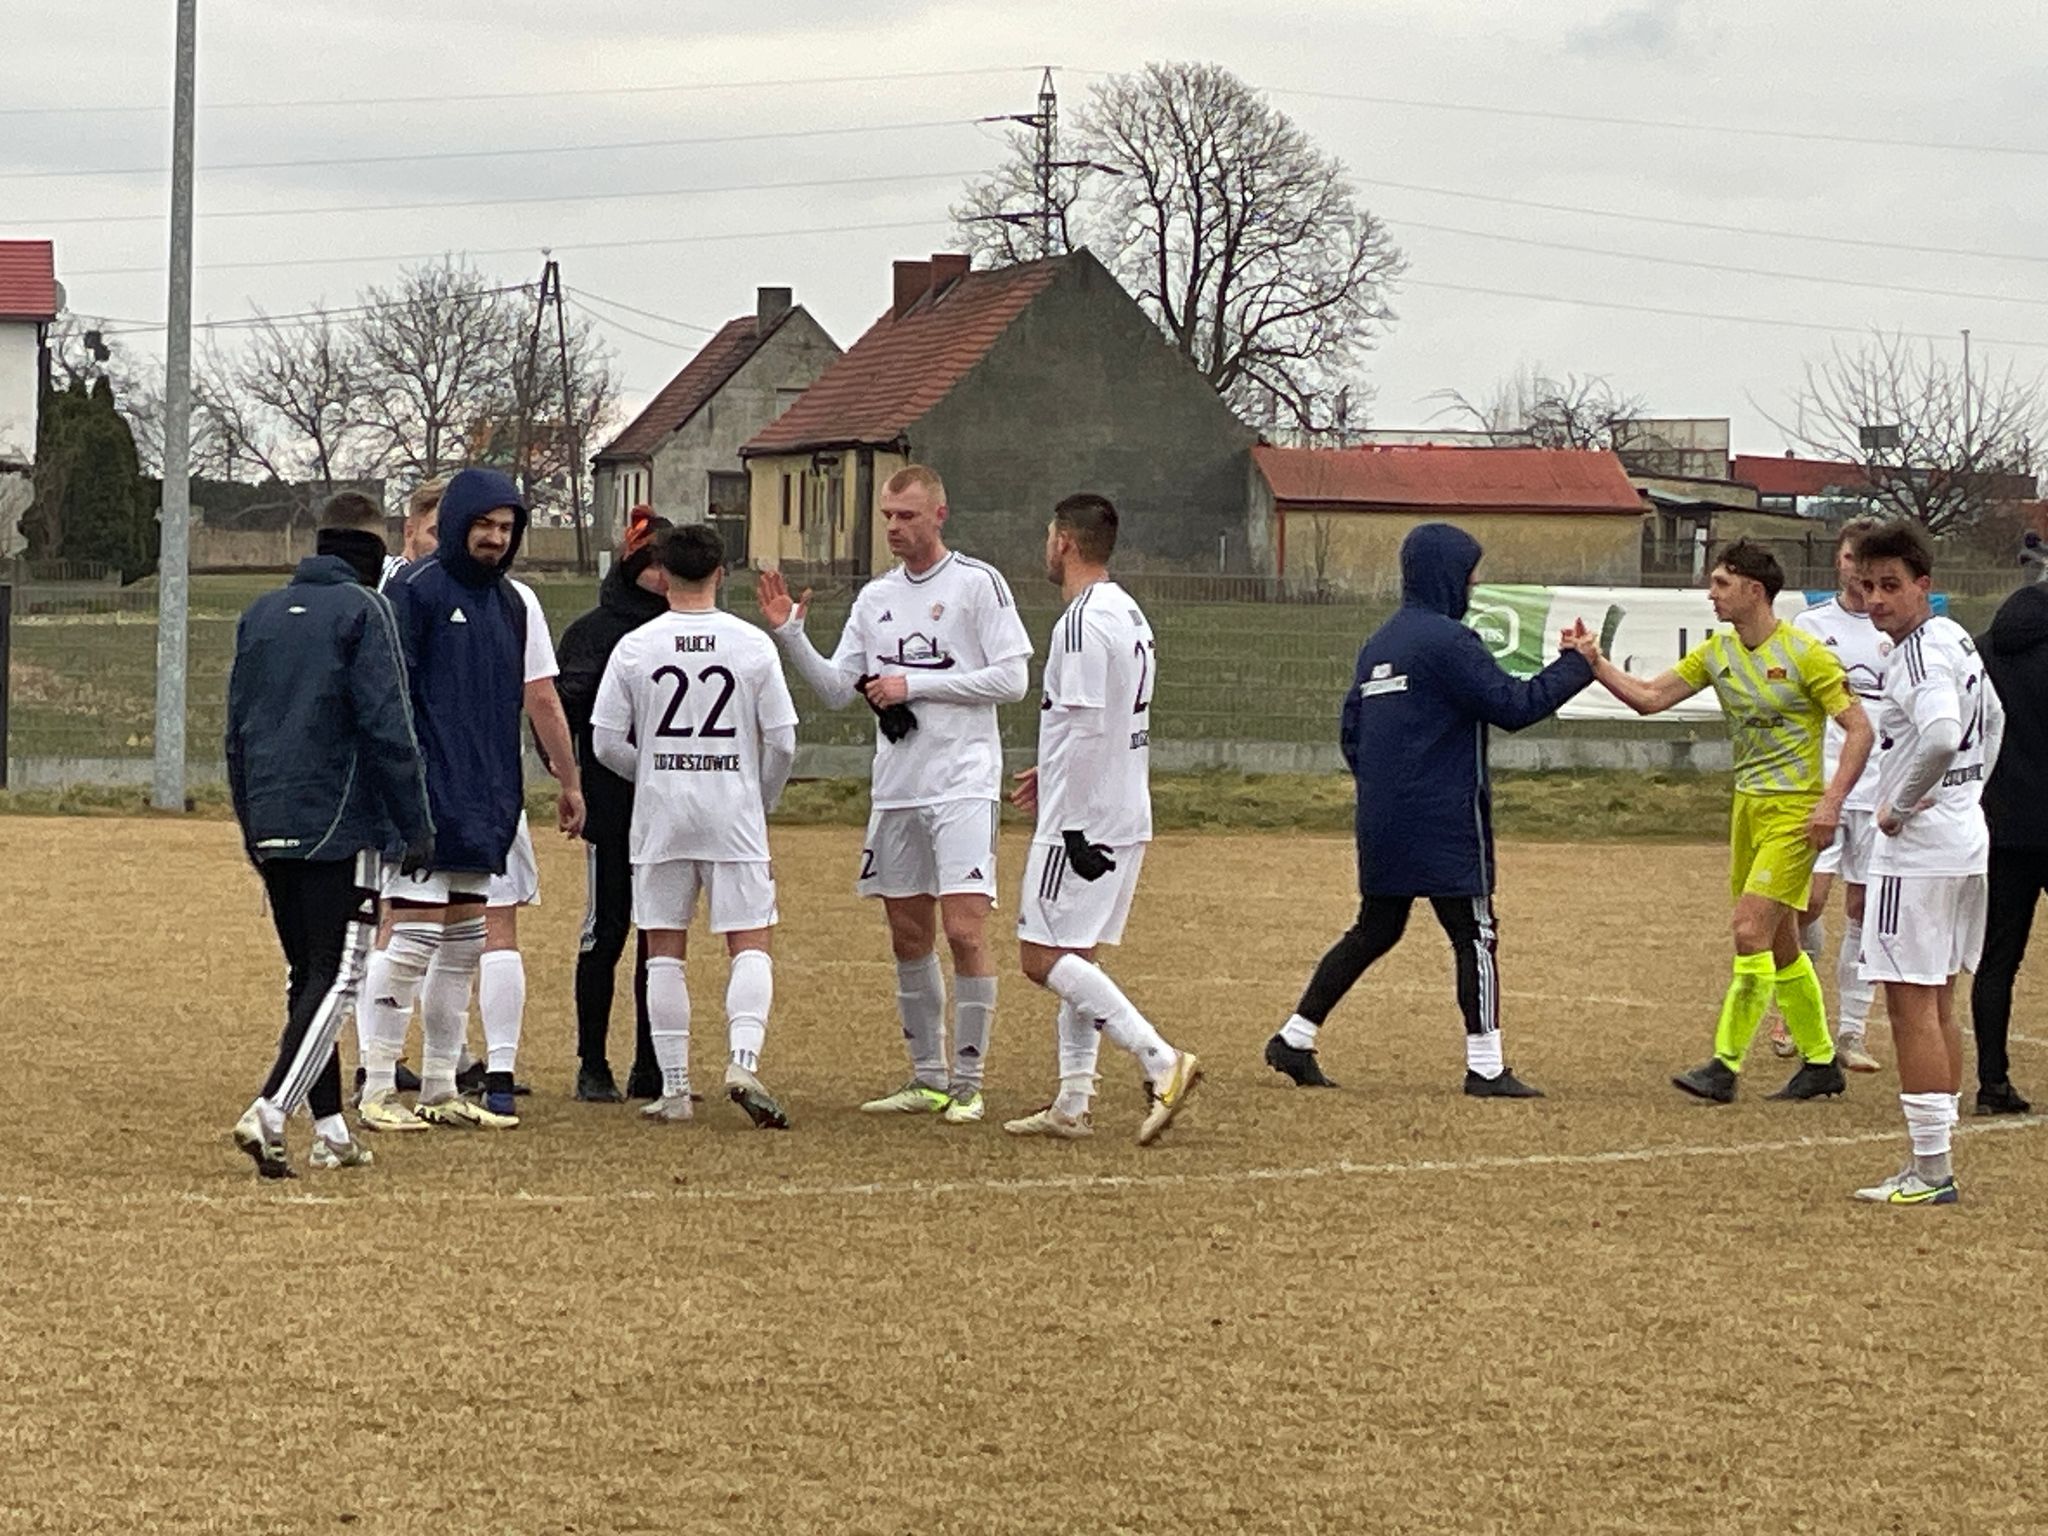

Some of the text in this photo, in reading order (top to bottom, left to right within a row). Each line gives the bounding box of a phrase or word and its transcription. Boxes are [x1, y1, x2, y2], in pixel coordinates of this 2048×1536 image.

[674, 634, 717, 653] RUCH
[651, 664, 737, 738] 22
[860, 848, 878, 880] 2
